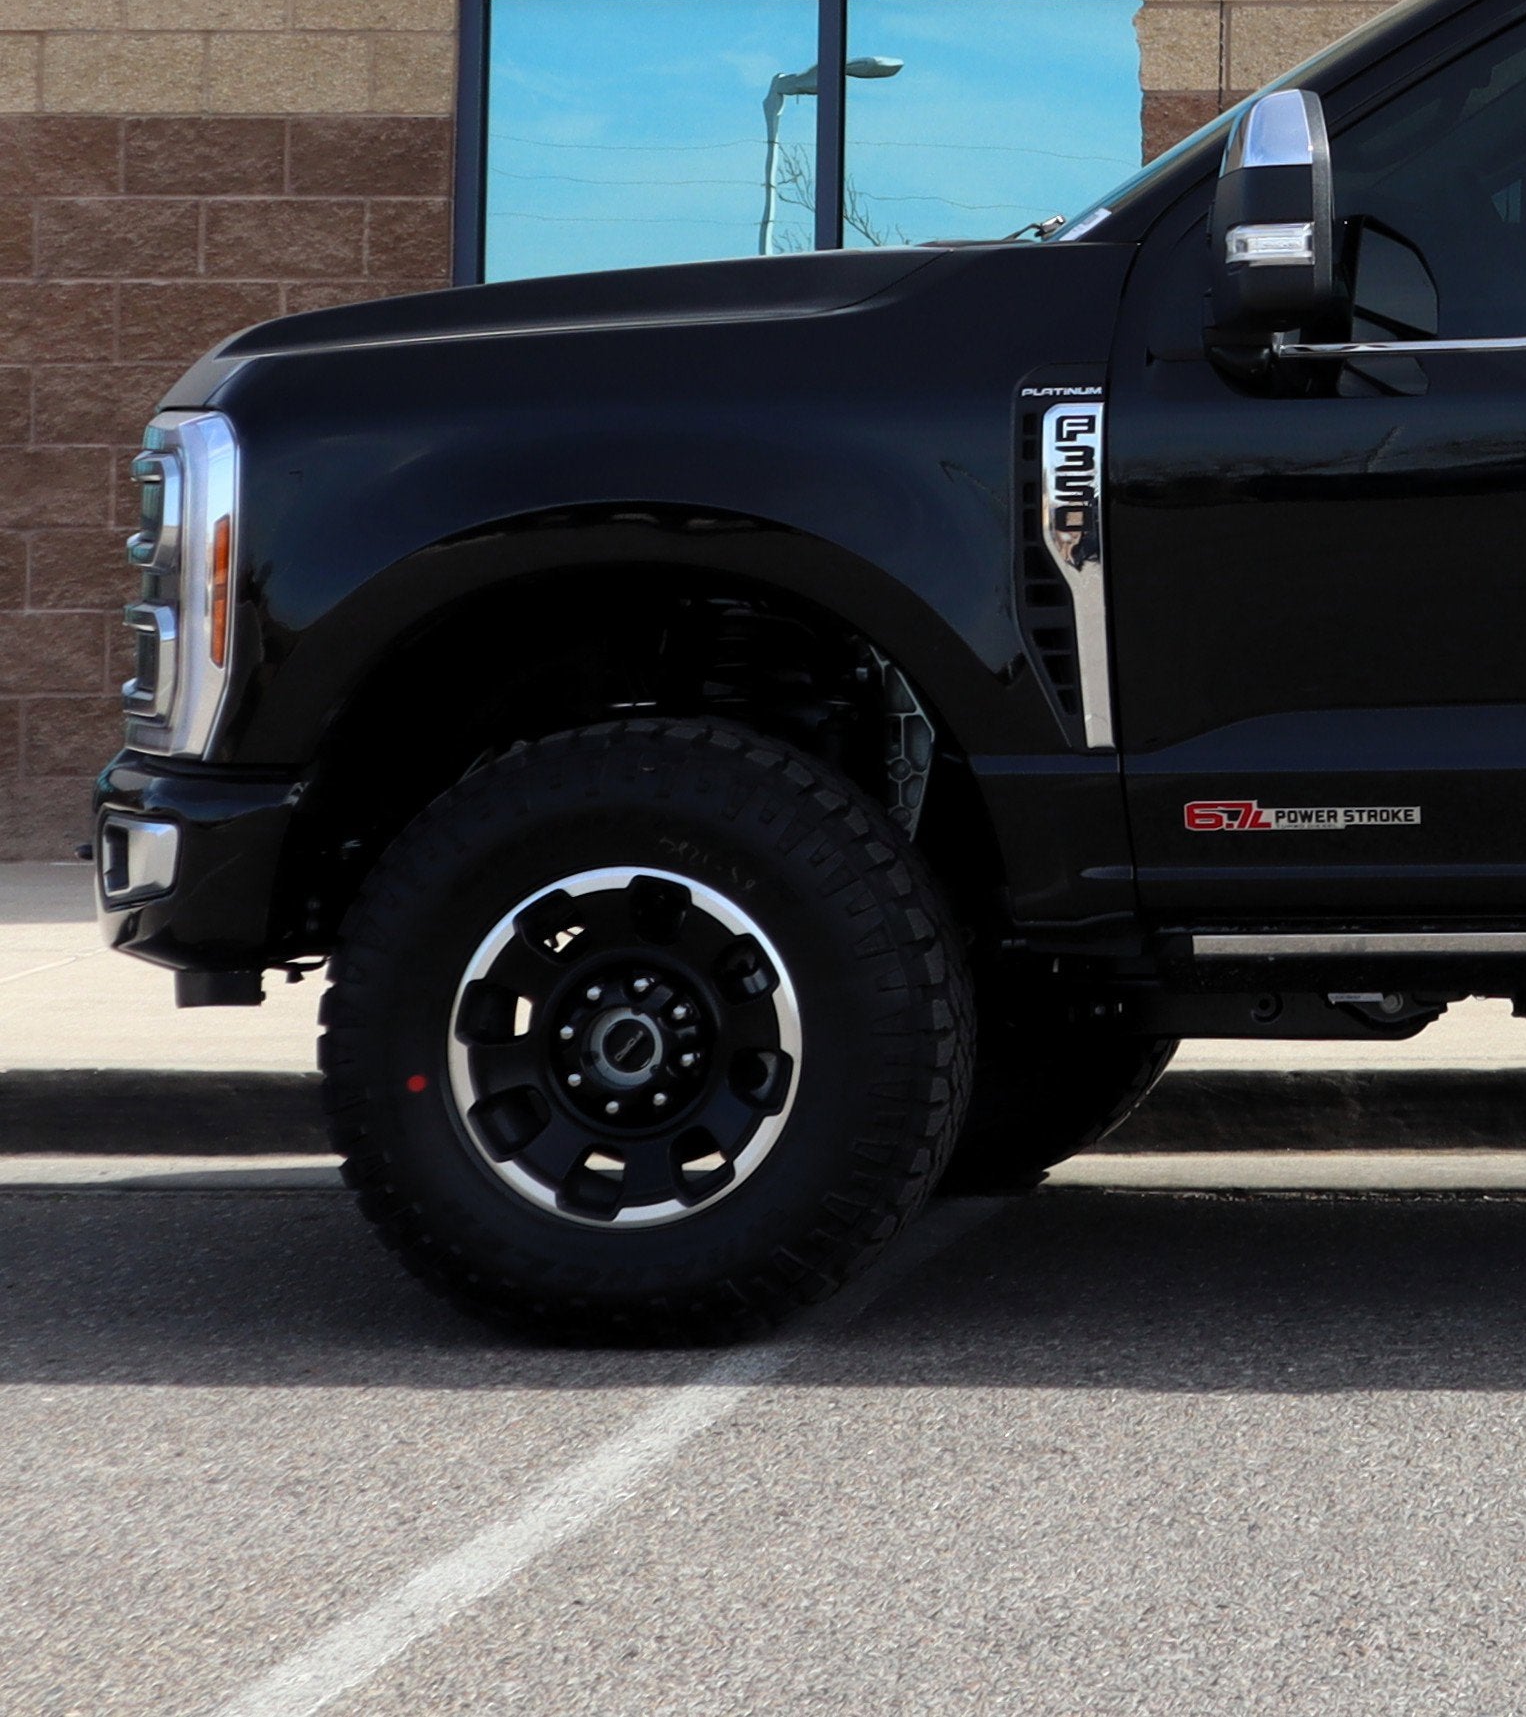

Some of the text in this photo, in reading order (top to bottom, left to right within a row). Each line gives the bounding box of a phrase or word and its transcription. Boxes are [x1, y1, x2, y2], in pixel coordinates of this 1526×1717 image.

[1021, 386, 1103, 397] PLATINUM
[1054, 414, 1097, 533] F350
[1185, 801, 1415, 830] 6.7L POWER STROKE
